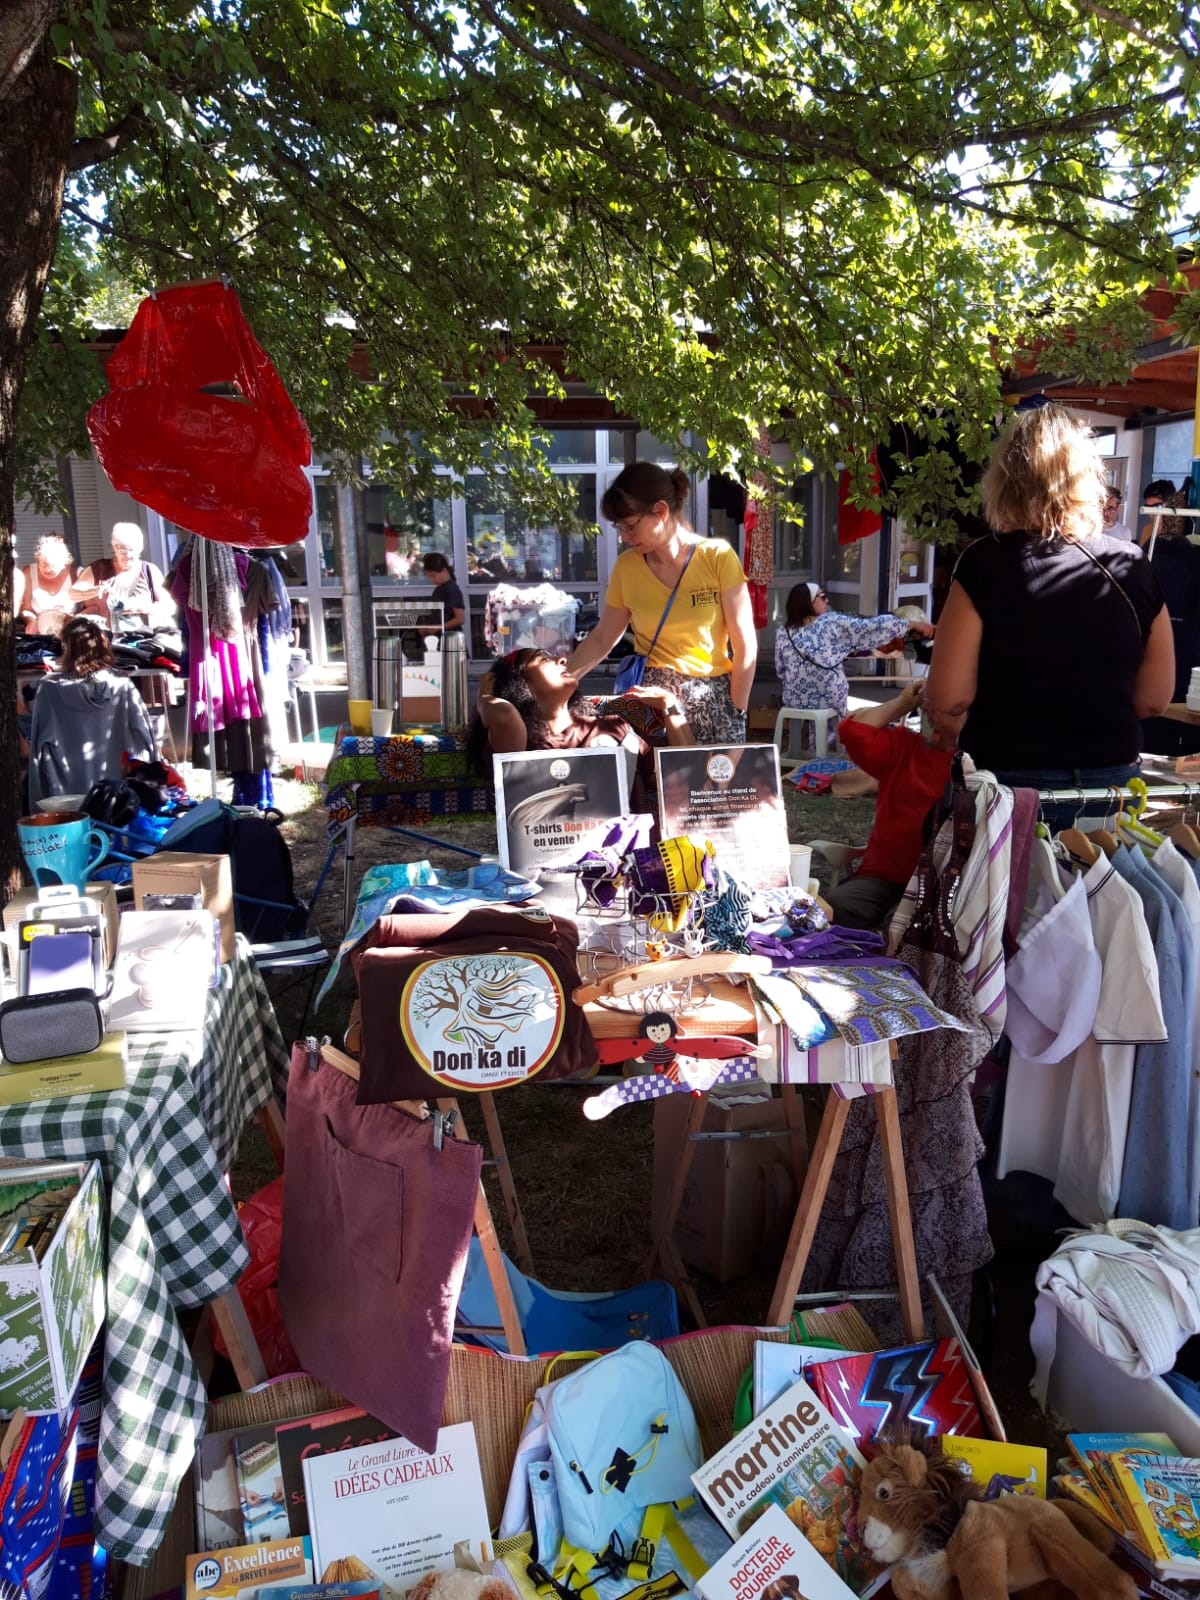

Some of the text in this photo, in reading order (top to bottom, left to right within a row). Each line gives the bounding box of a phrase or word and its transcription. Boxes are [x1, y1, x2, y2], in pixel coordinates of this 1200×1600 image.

[689, 805, 712, 813] chaque
[707, 812, 738, 820] promotion
[524, 823, 562, 835] T-shirts
[564, 822, 583, 832] Don
[534, 838, 546, 847] en
[548, 836, 575, 846] vente
[433, 1046, 526, 1072] Don ka di
[348, 1457, 359, 1471] Le
[361, 1452, 390, 1468] Grand
[393, 1446, 416, 1459] Livre
[708, 1400, 820, 1507] martine
[334, 1472, 381, 1498] IDÉES
[384, 1454, 454, 1487] CADEAUX
[727, 1507, 737, 1519] et
[737, 1500, 746, 1510] le
[746, 1472, 776, 1500] cadeau
[776, 1423, 831, 1473] d'anniversaire
[224, 1544, 301, 1574] Excellence
[729, 1536, 781, 1591] DOCTEUR
[736, 1543, 796, 1600] FOURRURE
[197, 1565, 218, 1579] abc
[240, 1567, 267, 1582] BREVET
